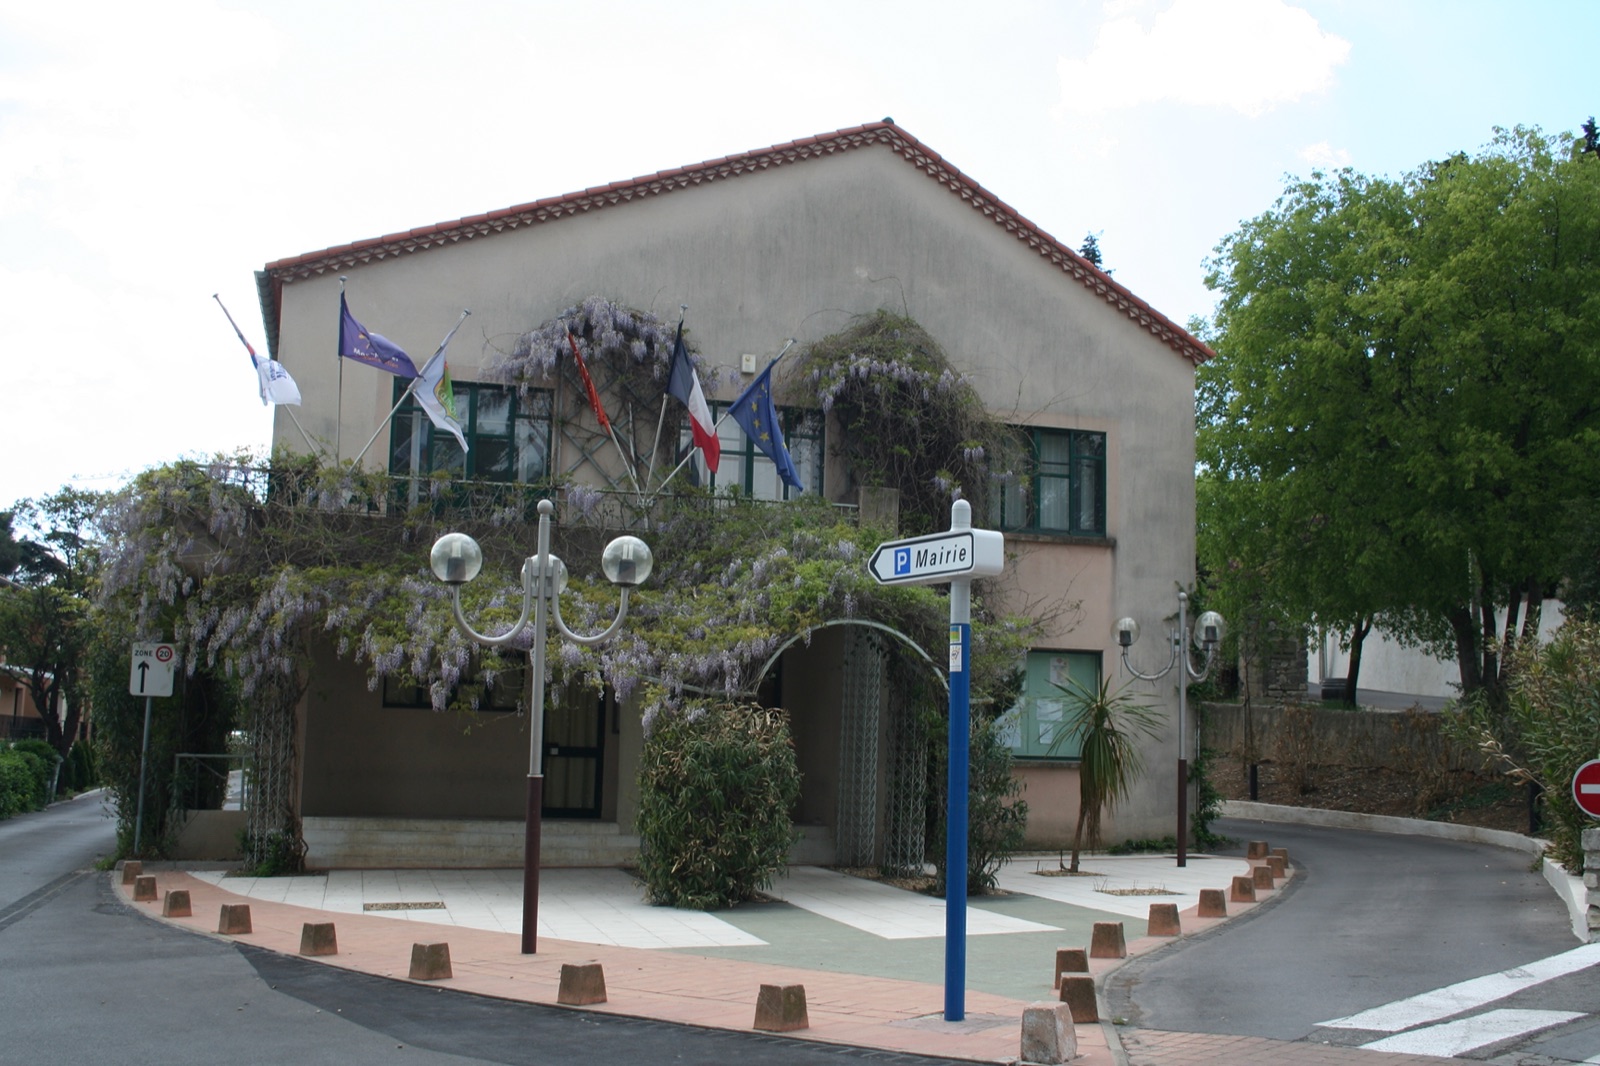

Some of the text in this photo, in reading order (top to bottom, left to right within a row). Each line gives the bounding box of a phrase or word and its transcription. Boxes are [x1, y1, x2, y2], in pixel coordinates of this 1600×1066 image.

[896, 544, 966, 571] P Mairie
[159, 650, 170, 658] 20
